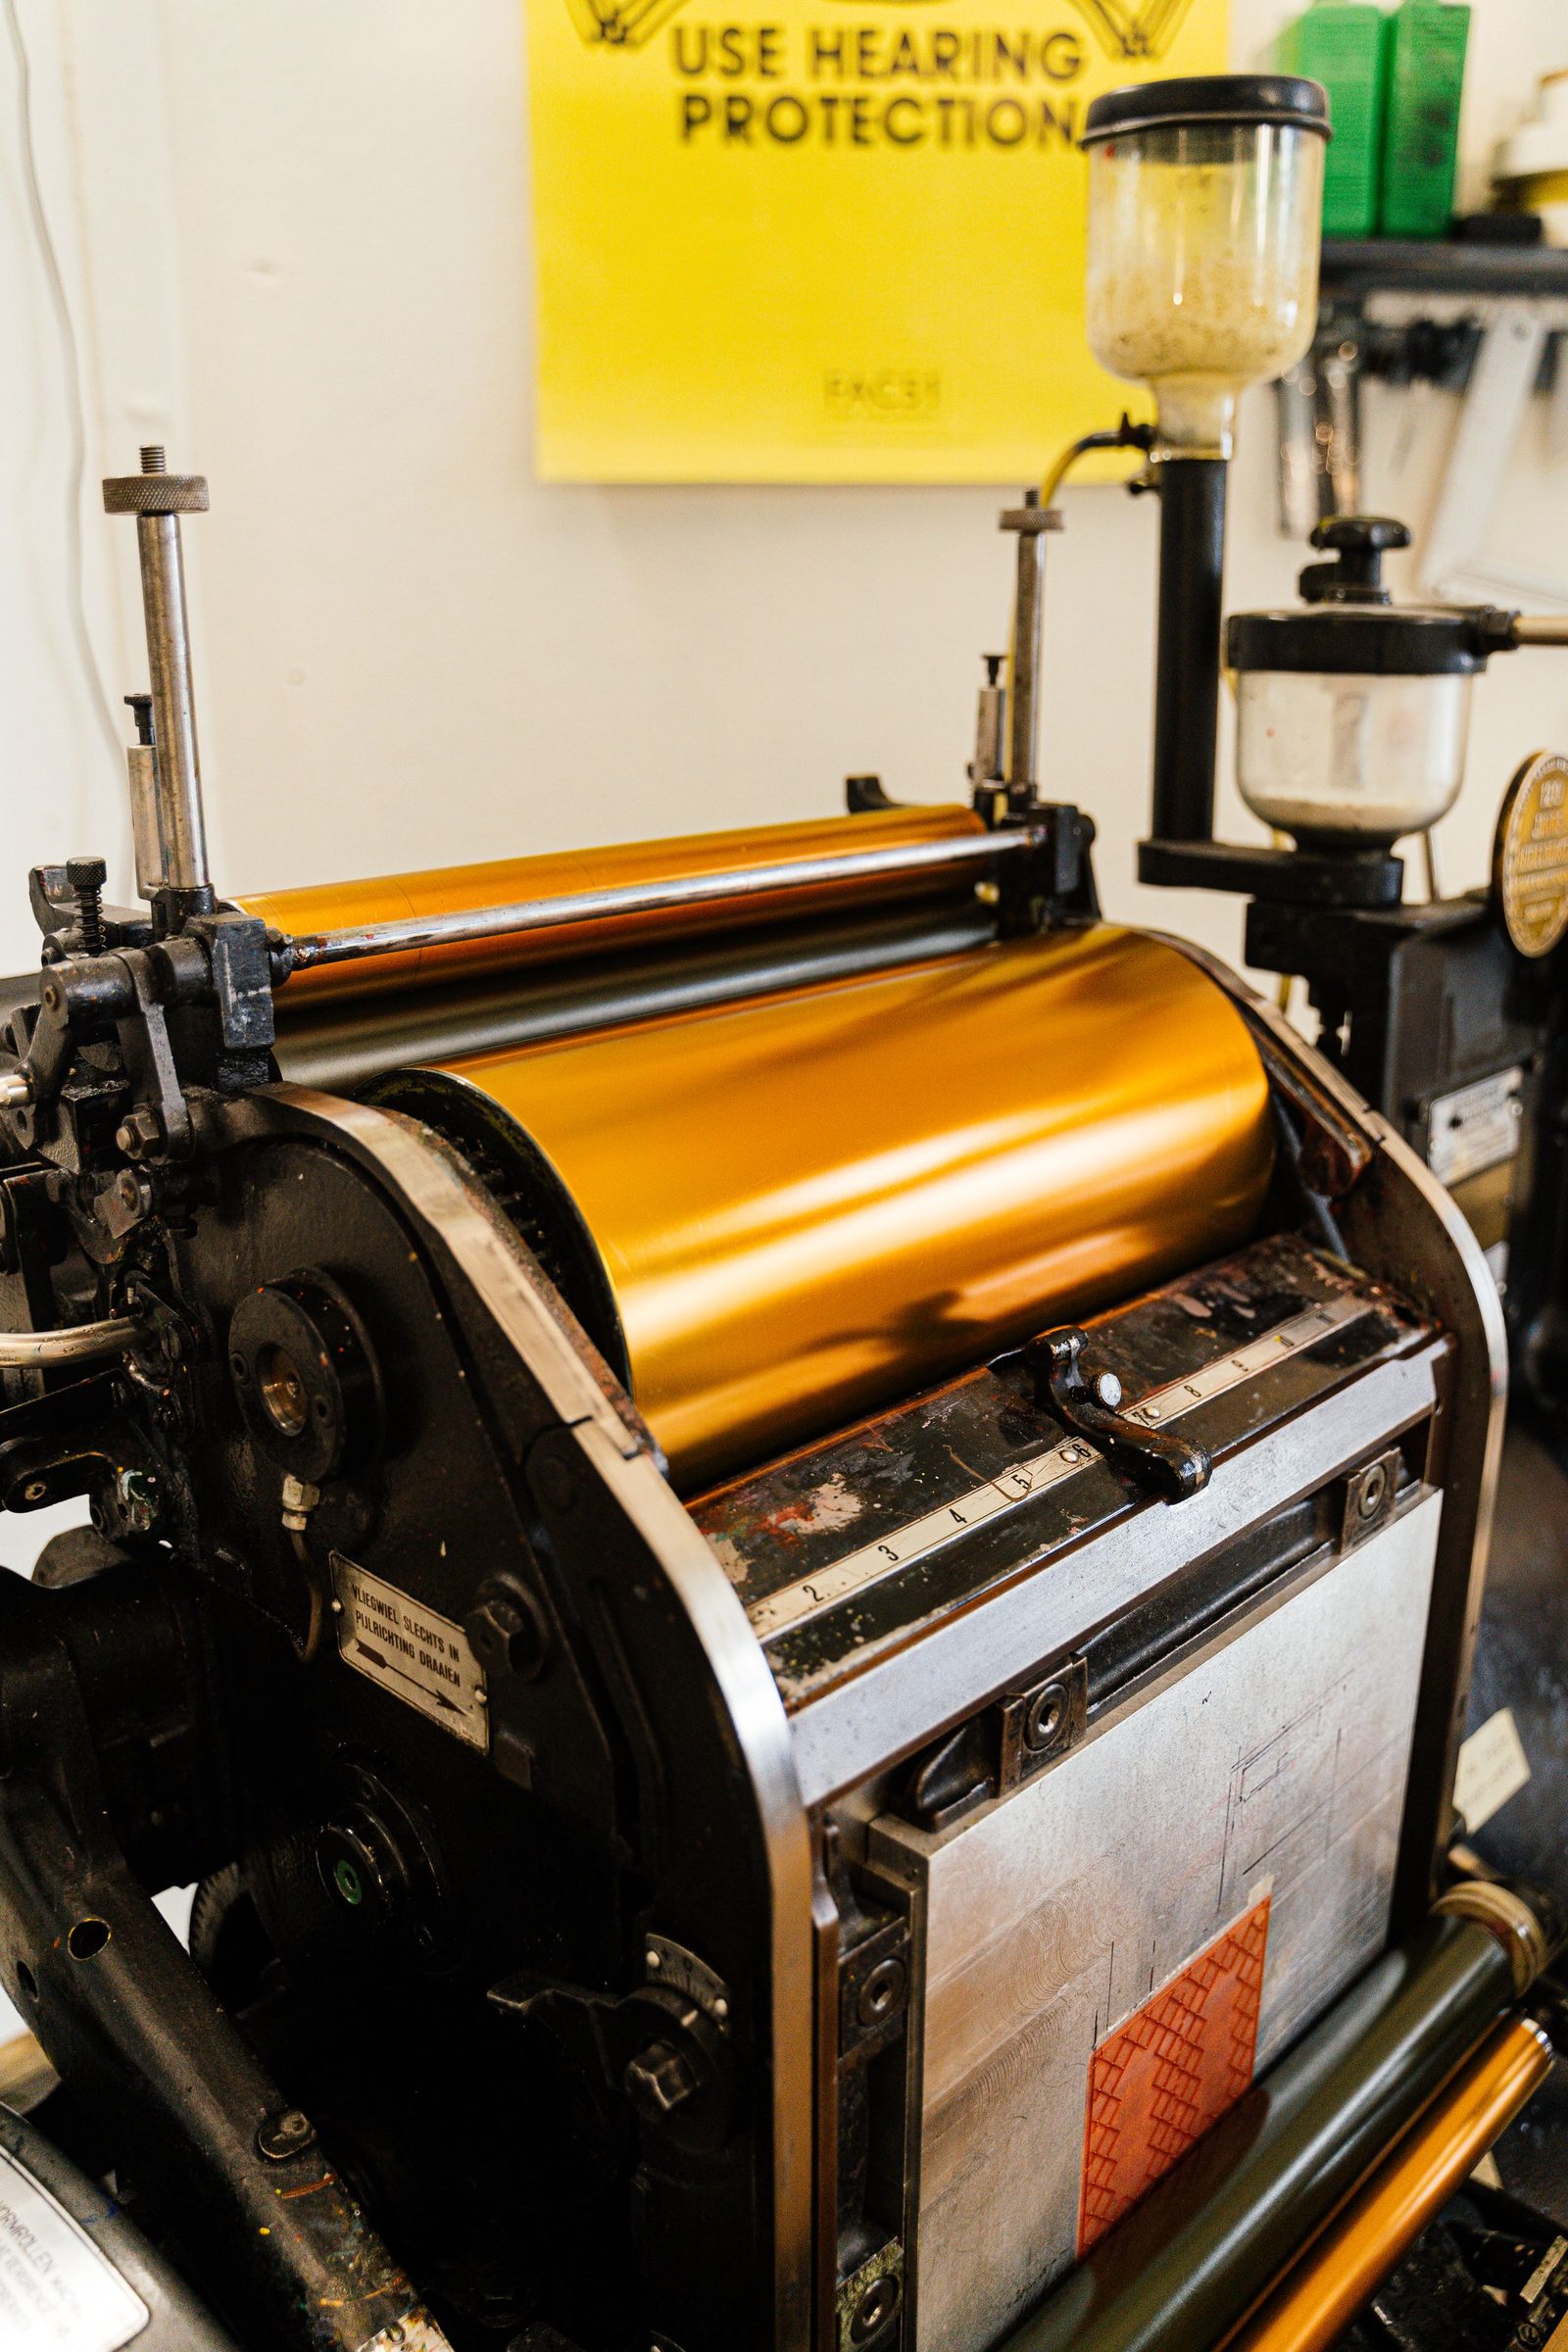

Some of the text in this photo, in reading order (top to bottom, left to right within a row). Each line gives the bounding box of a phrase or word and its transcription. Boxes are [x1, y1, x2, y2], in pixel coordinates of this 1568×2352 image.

[673, 26, 1083, 80] USE HEARING
[681, 95, 1077, 147] PROTECTION
[803, 1584, 823, 1602] 2
[877, 1544, 900, 1562] 3
[950, 1508, 968, 1525] 4
[1010, 1474, 1029, 1490] 5
[1073, 1444, 1092, 1458] 6
[1132, 1411, 1151, 1426] 7
[1183, 1385, 1202, 1398] 8
[352, 1585, 460, 1662] VLIEGWIEL SLECHTS IN
[356, 1610, 461, 1688] PIJLRICHTING DRAAIEN
